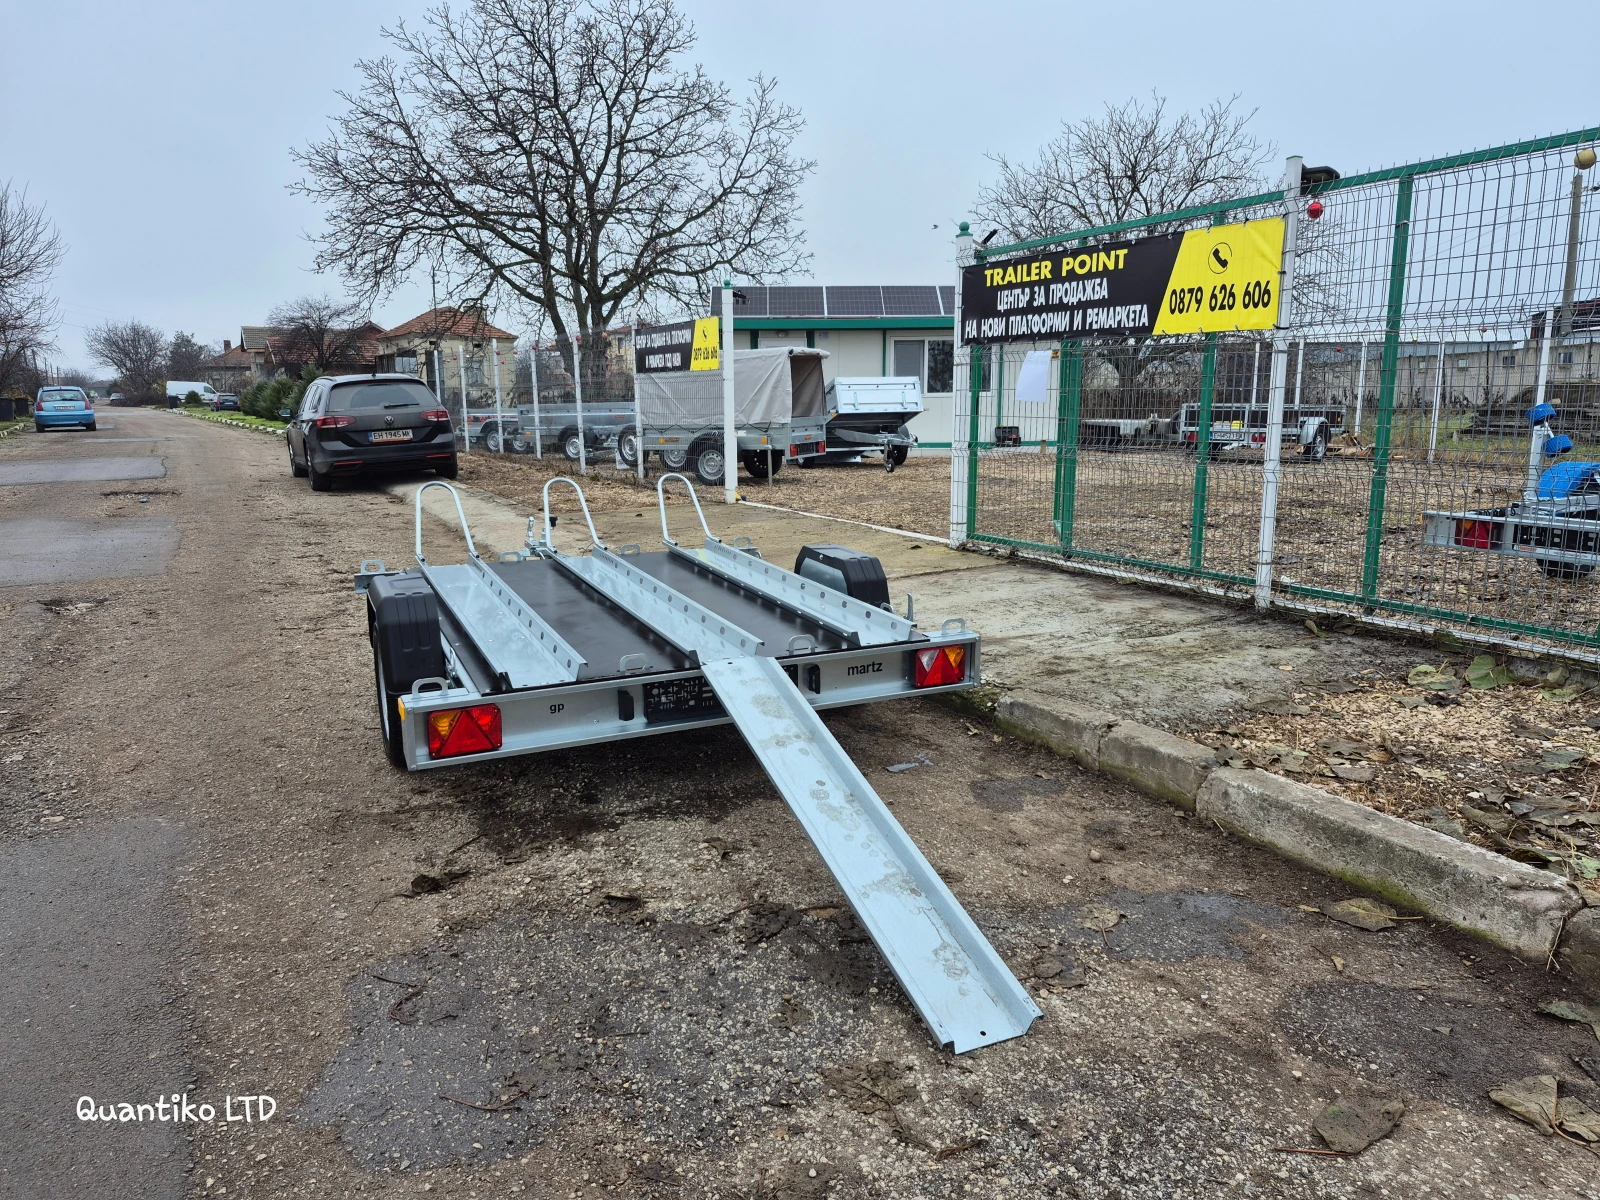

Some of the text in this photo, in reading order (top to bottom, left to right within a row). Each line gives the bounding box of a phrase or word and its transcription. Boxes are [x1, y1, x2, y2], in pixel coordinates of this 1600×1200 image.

[984, 249, 1128, 287] TRAILER POINT
[997, 277, 1109, 313] ЦЕНТЪР ЗА ПРОДАЖБА
[1169, 280, 1272, 315] 0879 626 606
[965, 303, 1149, 339] НА НОВИ ПЛАТФОРМИ И РЕМАРКЕТА
[847, 661, 883, 676] martz
[549, 703, 565, 714] gp
